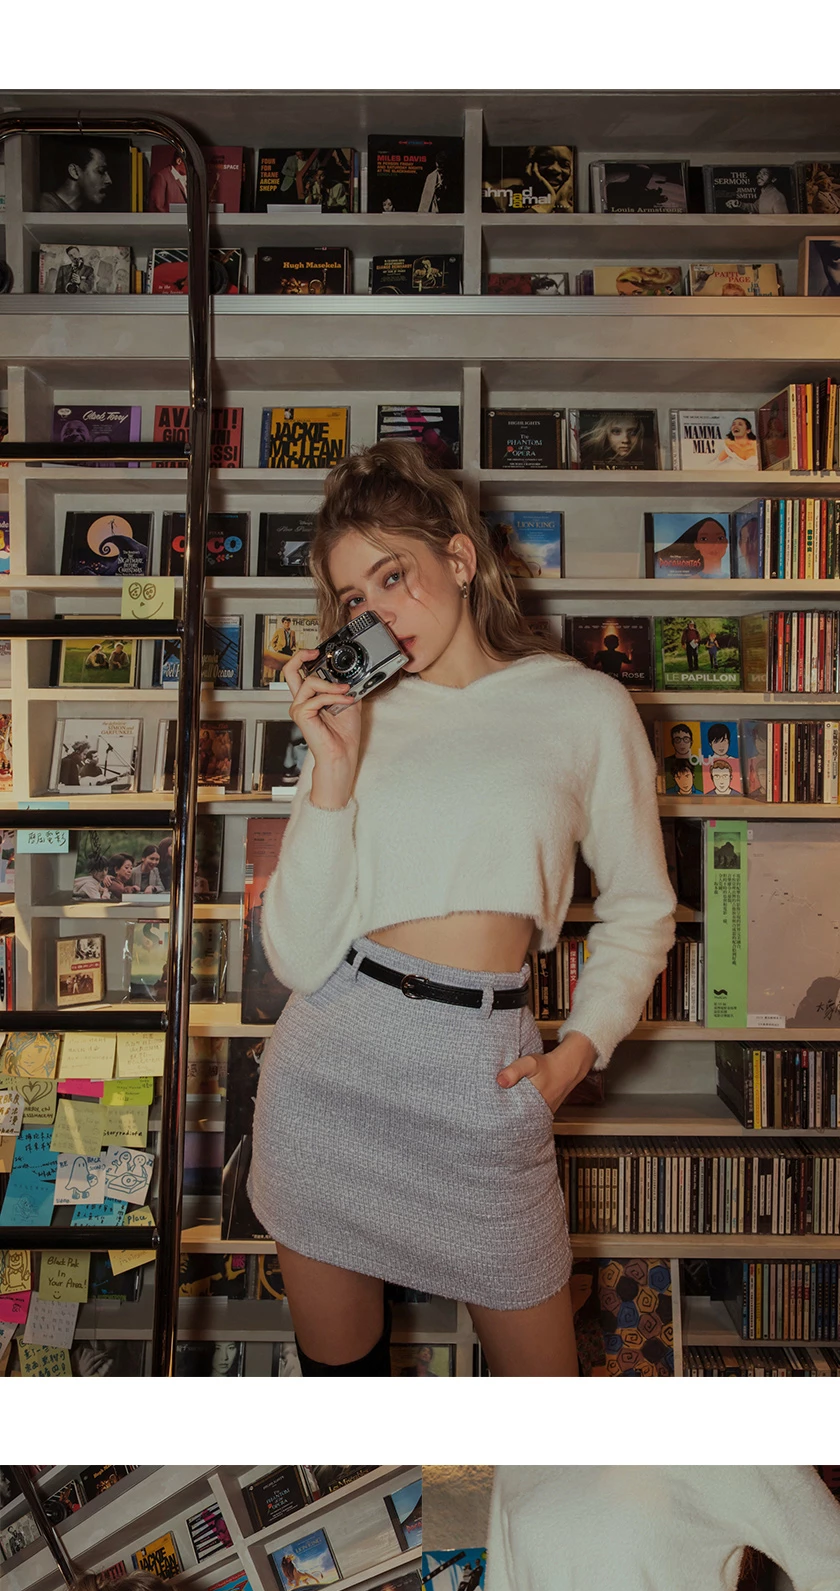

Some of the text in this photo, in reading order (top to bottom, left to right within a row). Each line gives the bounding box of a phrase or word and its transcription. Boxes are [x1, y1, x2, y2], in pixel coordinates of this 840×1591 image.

[283, 262, 304, 270] Hugh
[158, 408, 237, 429] AVTI!
[272, 422, 330, 441] JACKIE
[684, 426, 722, 439] MAMMA
[693, 440, 715, 453] MIA!
[666, 673, 737, 682] LE PAPILLON
[57, 1270, 66, 1278] In
[48, 1278, 63, 1287] Your
